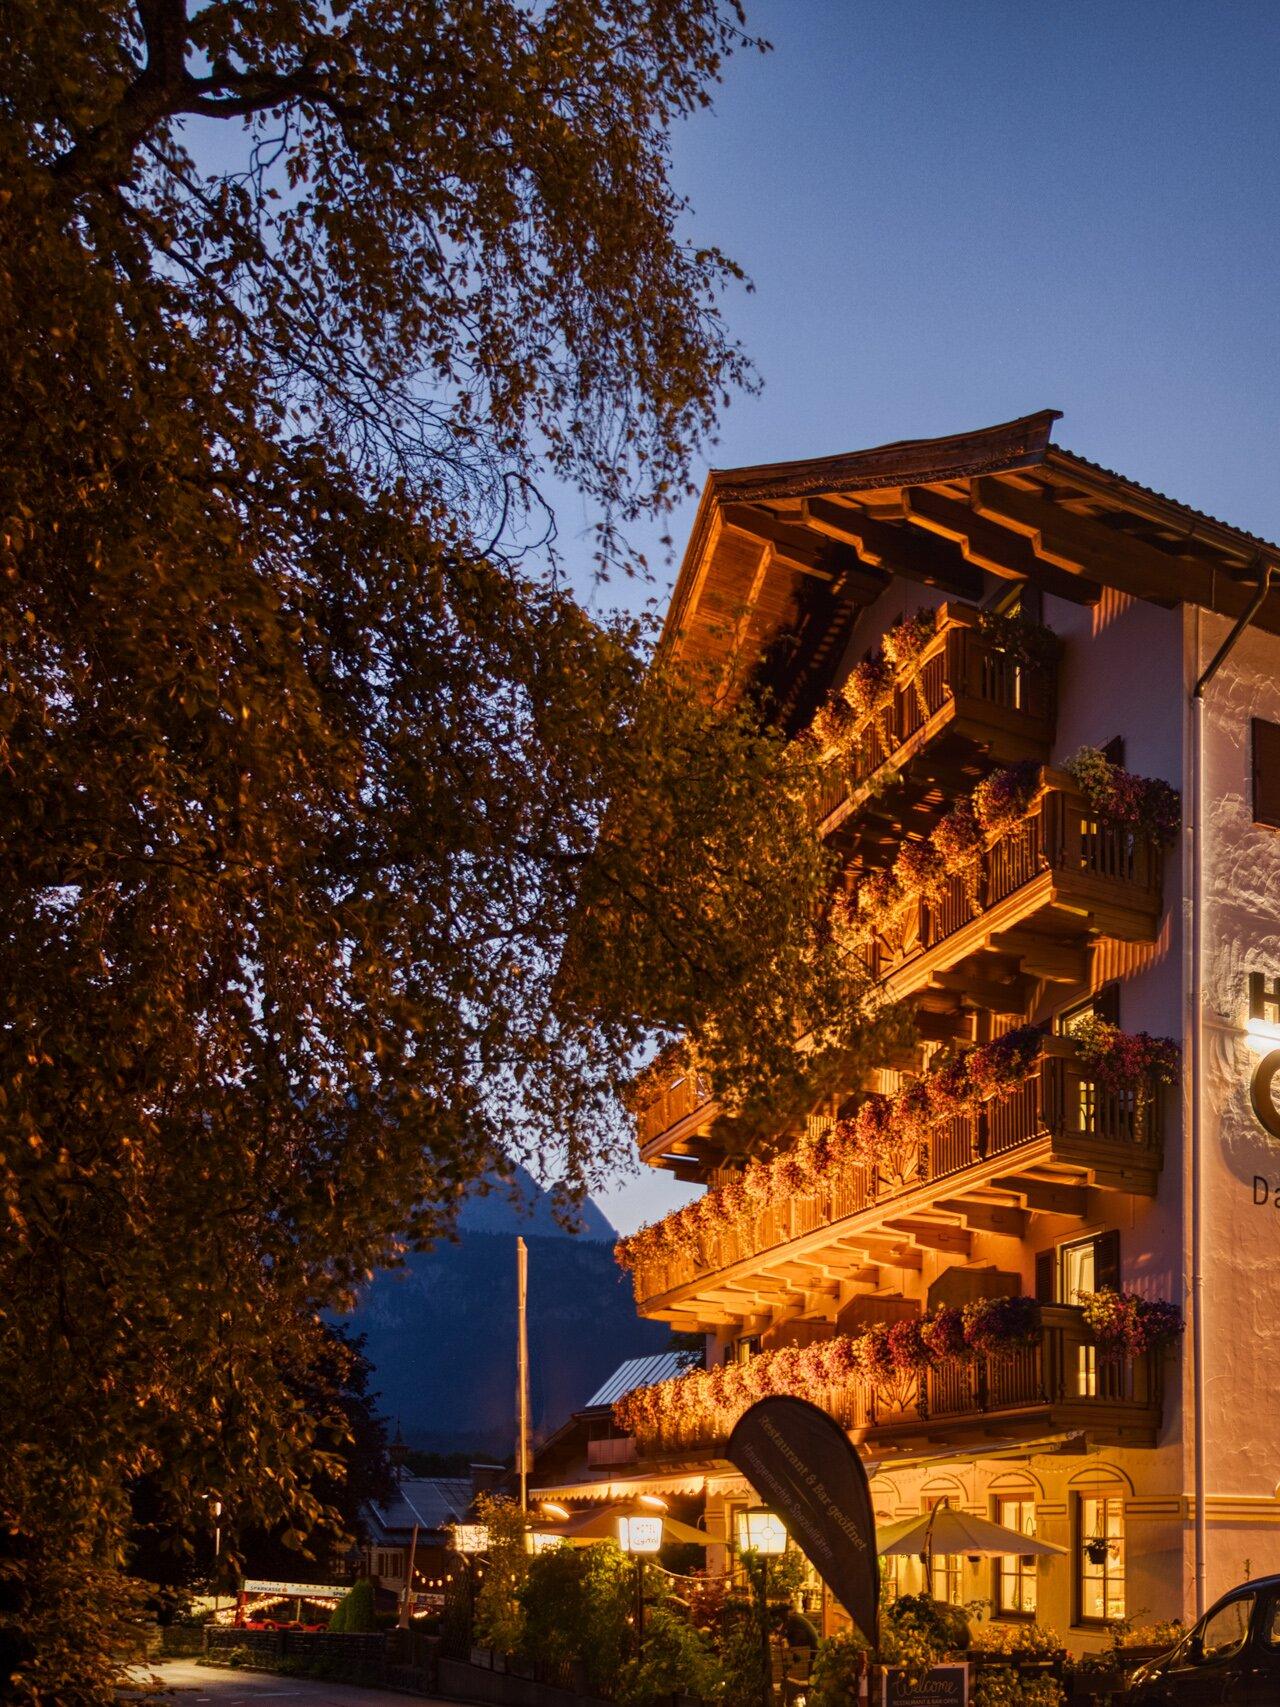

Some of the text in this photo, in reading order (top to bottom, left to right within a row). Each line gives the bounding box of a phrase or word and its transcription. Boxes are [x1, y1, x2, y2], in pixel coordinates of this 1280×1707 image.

[758, 1414, 868, 1552] Restaurant & Bar geöffnet
